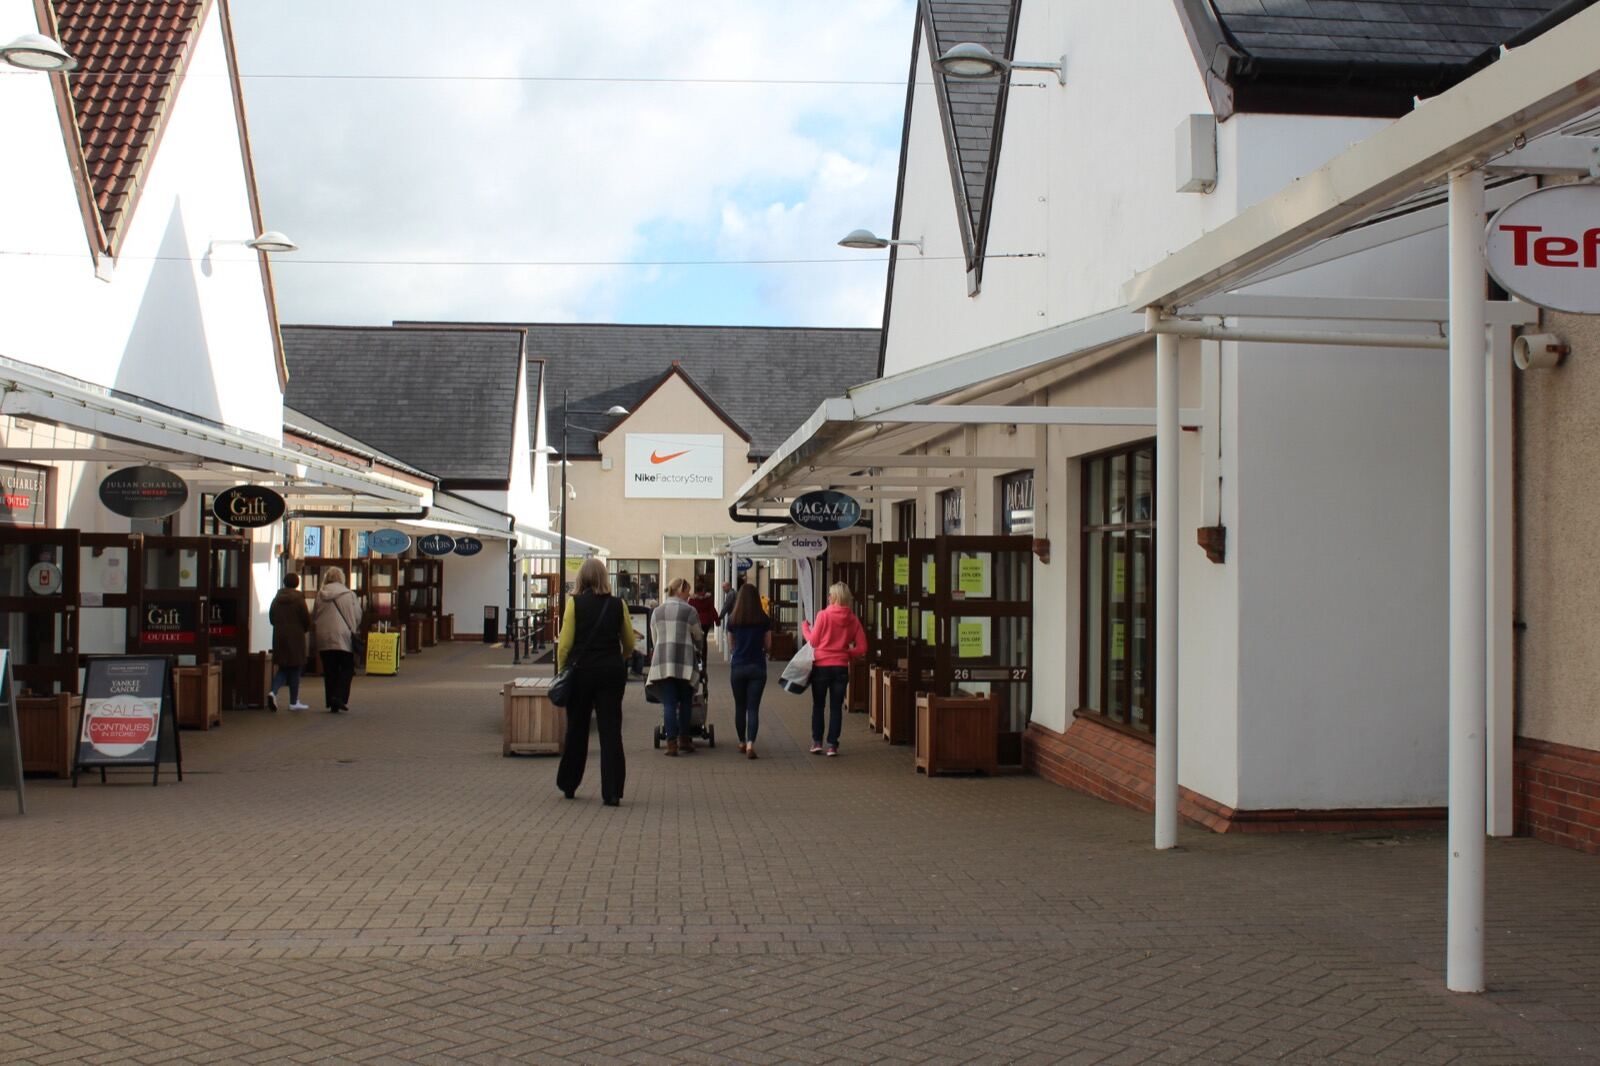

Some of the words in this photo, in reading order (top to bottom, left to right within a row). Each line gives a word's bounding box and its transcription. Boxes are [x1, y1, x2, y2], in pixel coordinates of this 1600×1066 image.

[7, 477, 43, 492] CHARLES
[106, 481, 139, 489] JULIAN
[142, 481, 183, 489] CHARLES
[230, 490, 242, 498] the
[7, 497, 30, 507] OUTLET
[230, 497, 268, 515] Gift
[795, 501, 856, 515] PAGAZZI
[230, 514, 268, 523] company
[798, 514, 824, 523] Lighting
[791, 538, 823, 548] claire's
[148, 608, 180, 625] Gift
[211, 604, 221, 620] ft
[147, 633, 181, 641] OUTLET
[368, 650, 392, 661] FREE
[954, 669, 969, 680] 26
[1013, 669, 1027, 680] 27
[111, 679, 141, 687] YANKEE
[101, 703, 144, 717] SALE
[90, 722, 150, 732] CONTINUES
